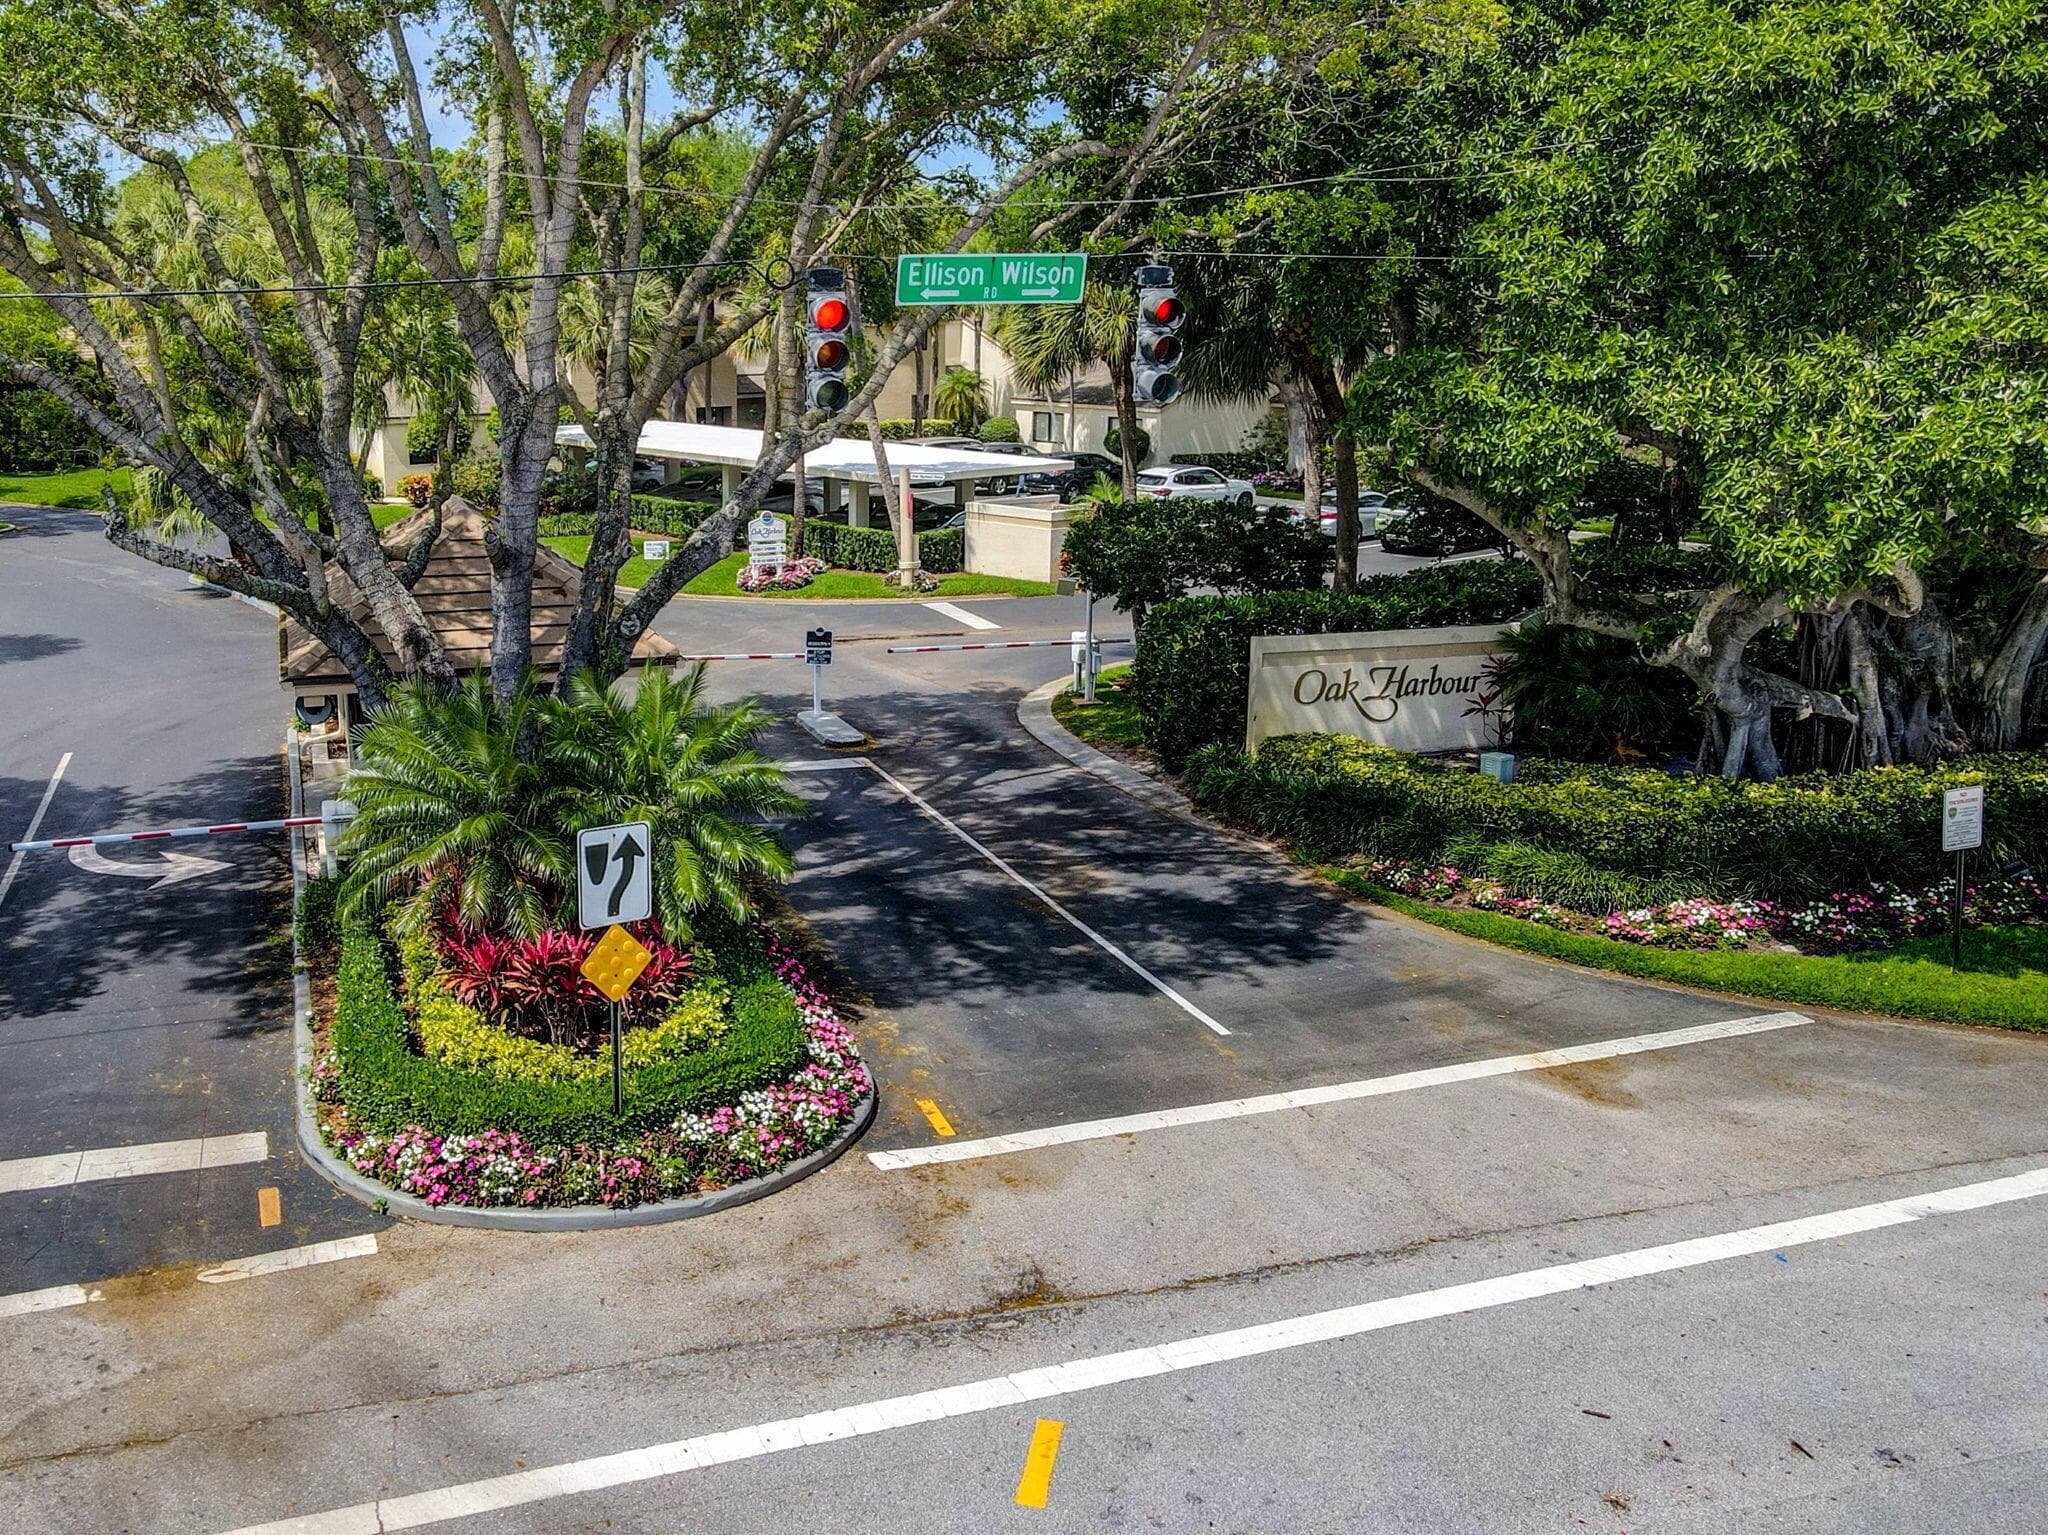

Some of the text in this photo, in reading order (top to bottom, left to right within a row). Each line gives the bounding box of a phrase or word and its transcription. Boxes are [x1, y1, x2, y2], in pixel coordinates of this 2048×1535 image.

[908, 261, 1075, 286] Ellison Wilson
[983, 286, 998, 299] RD
[1293, 664, 1480, 722] Oak Harbour
